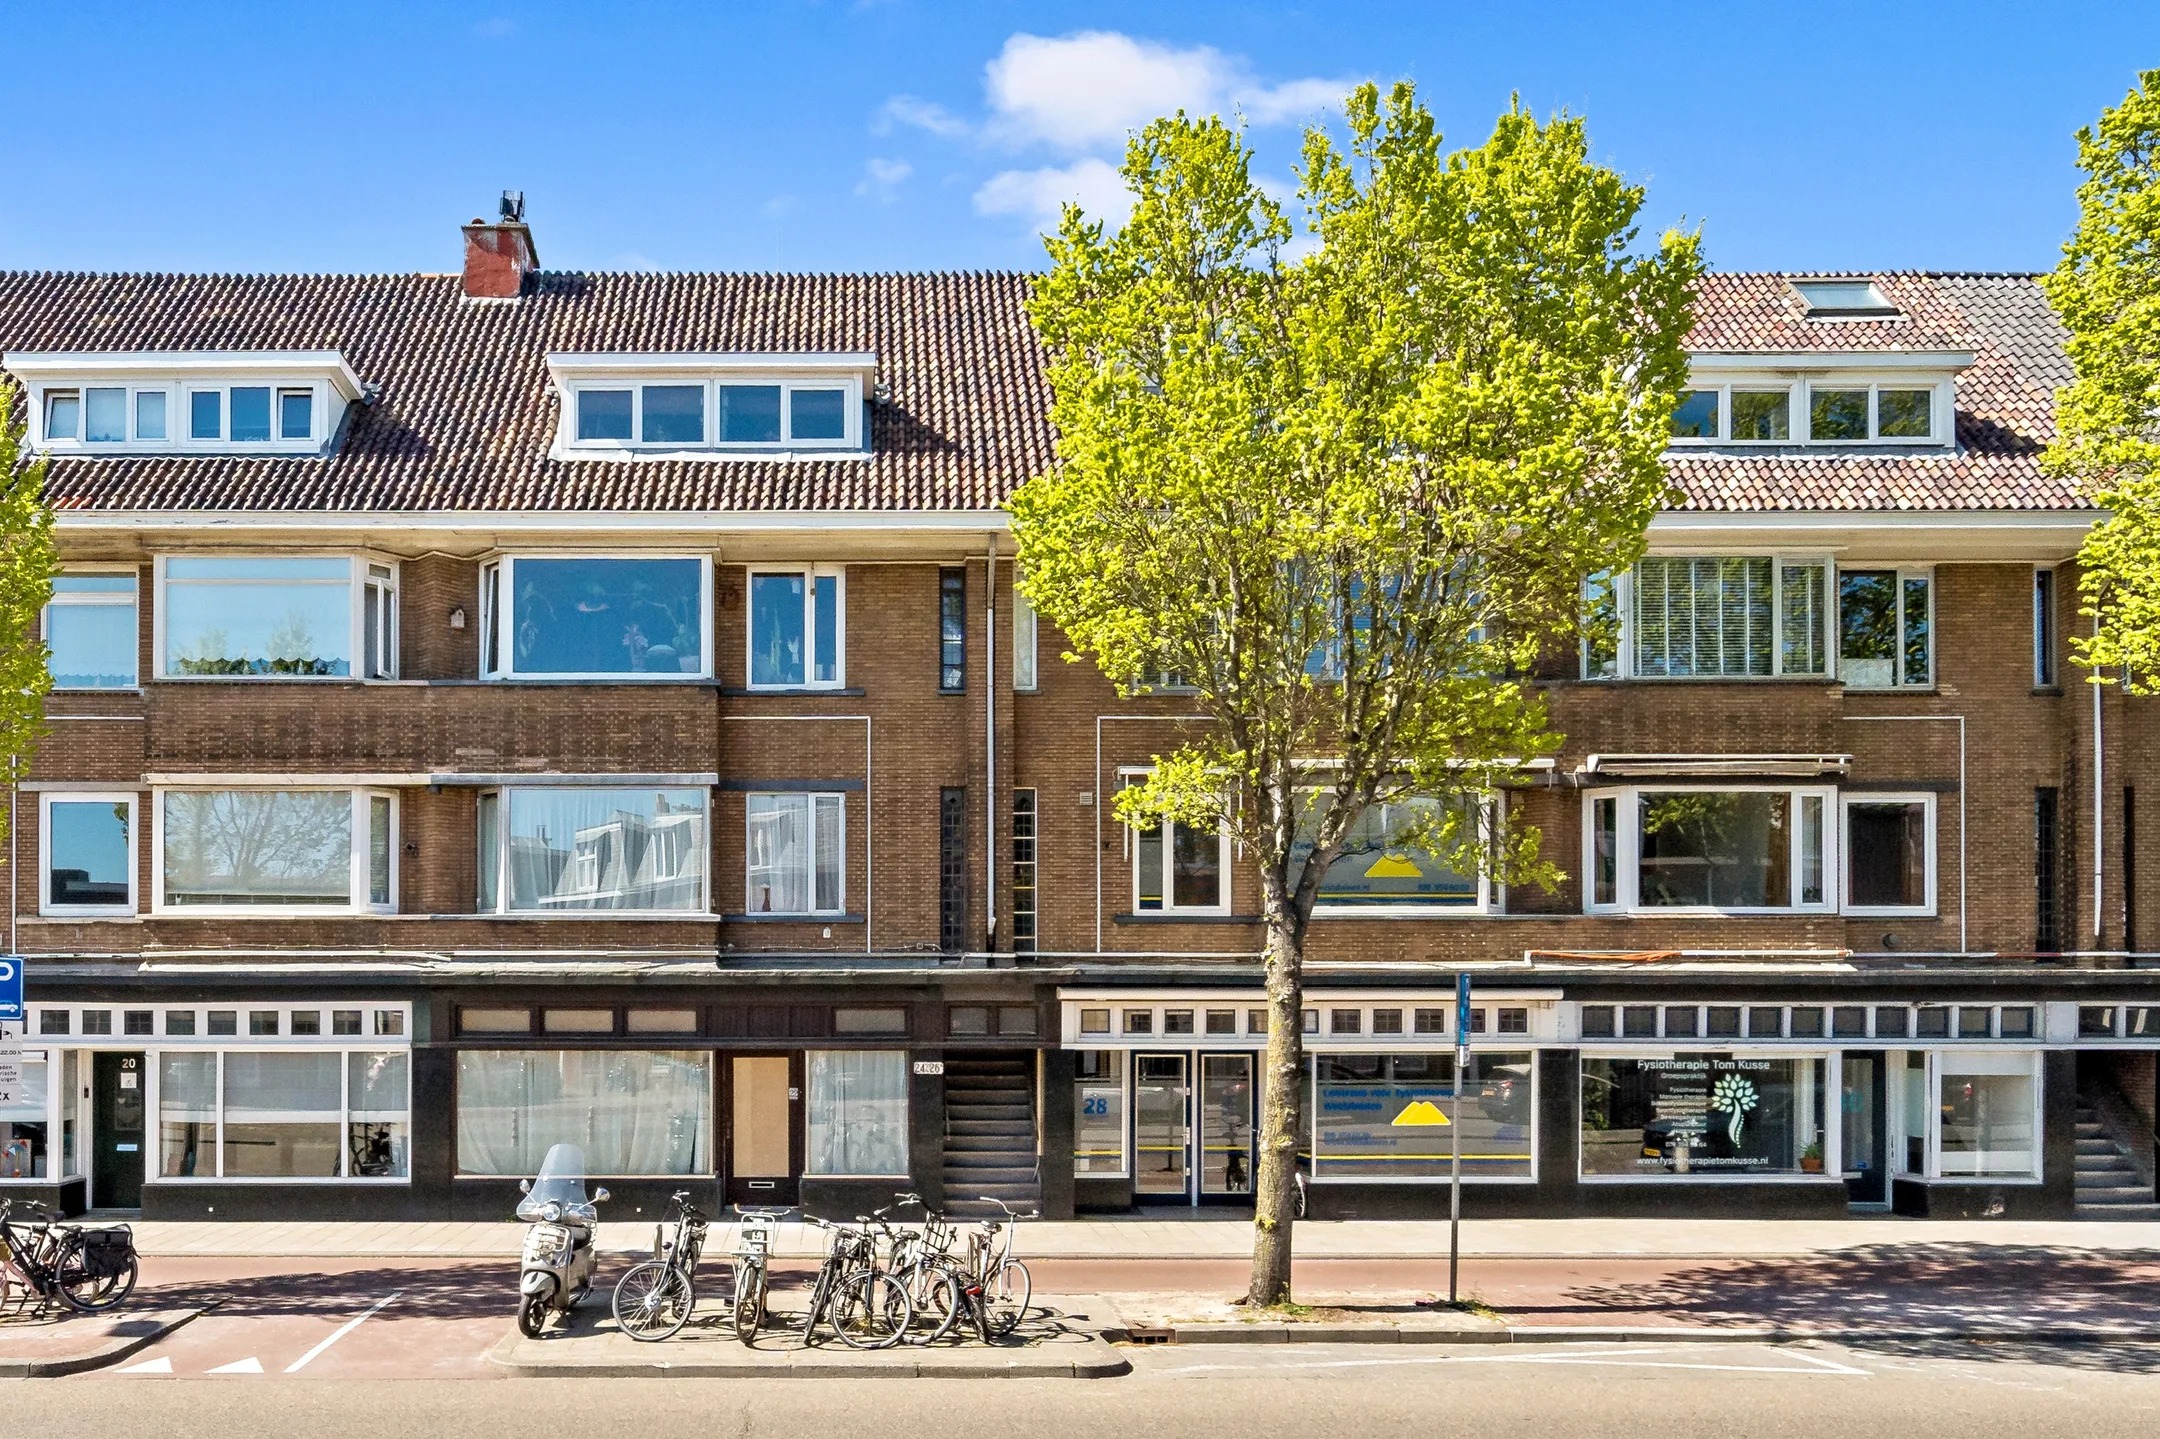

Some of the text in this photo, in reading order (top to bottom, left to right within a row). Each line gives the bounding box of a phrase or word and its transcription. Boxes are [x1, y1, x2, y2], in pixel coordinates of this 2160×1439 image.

[122, 1058, 136, 1069] 20
[1637, 1060, 1770, 1071] Fysiotherapie Tom Kusse
[1083, 1098, 1107, 1114] 28
[1636, 1157, 1769, 1167] www.fysiotherapietomkusse.nl
